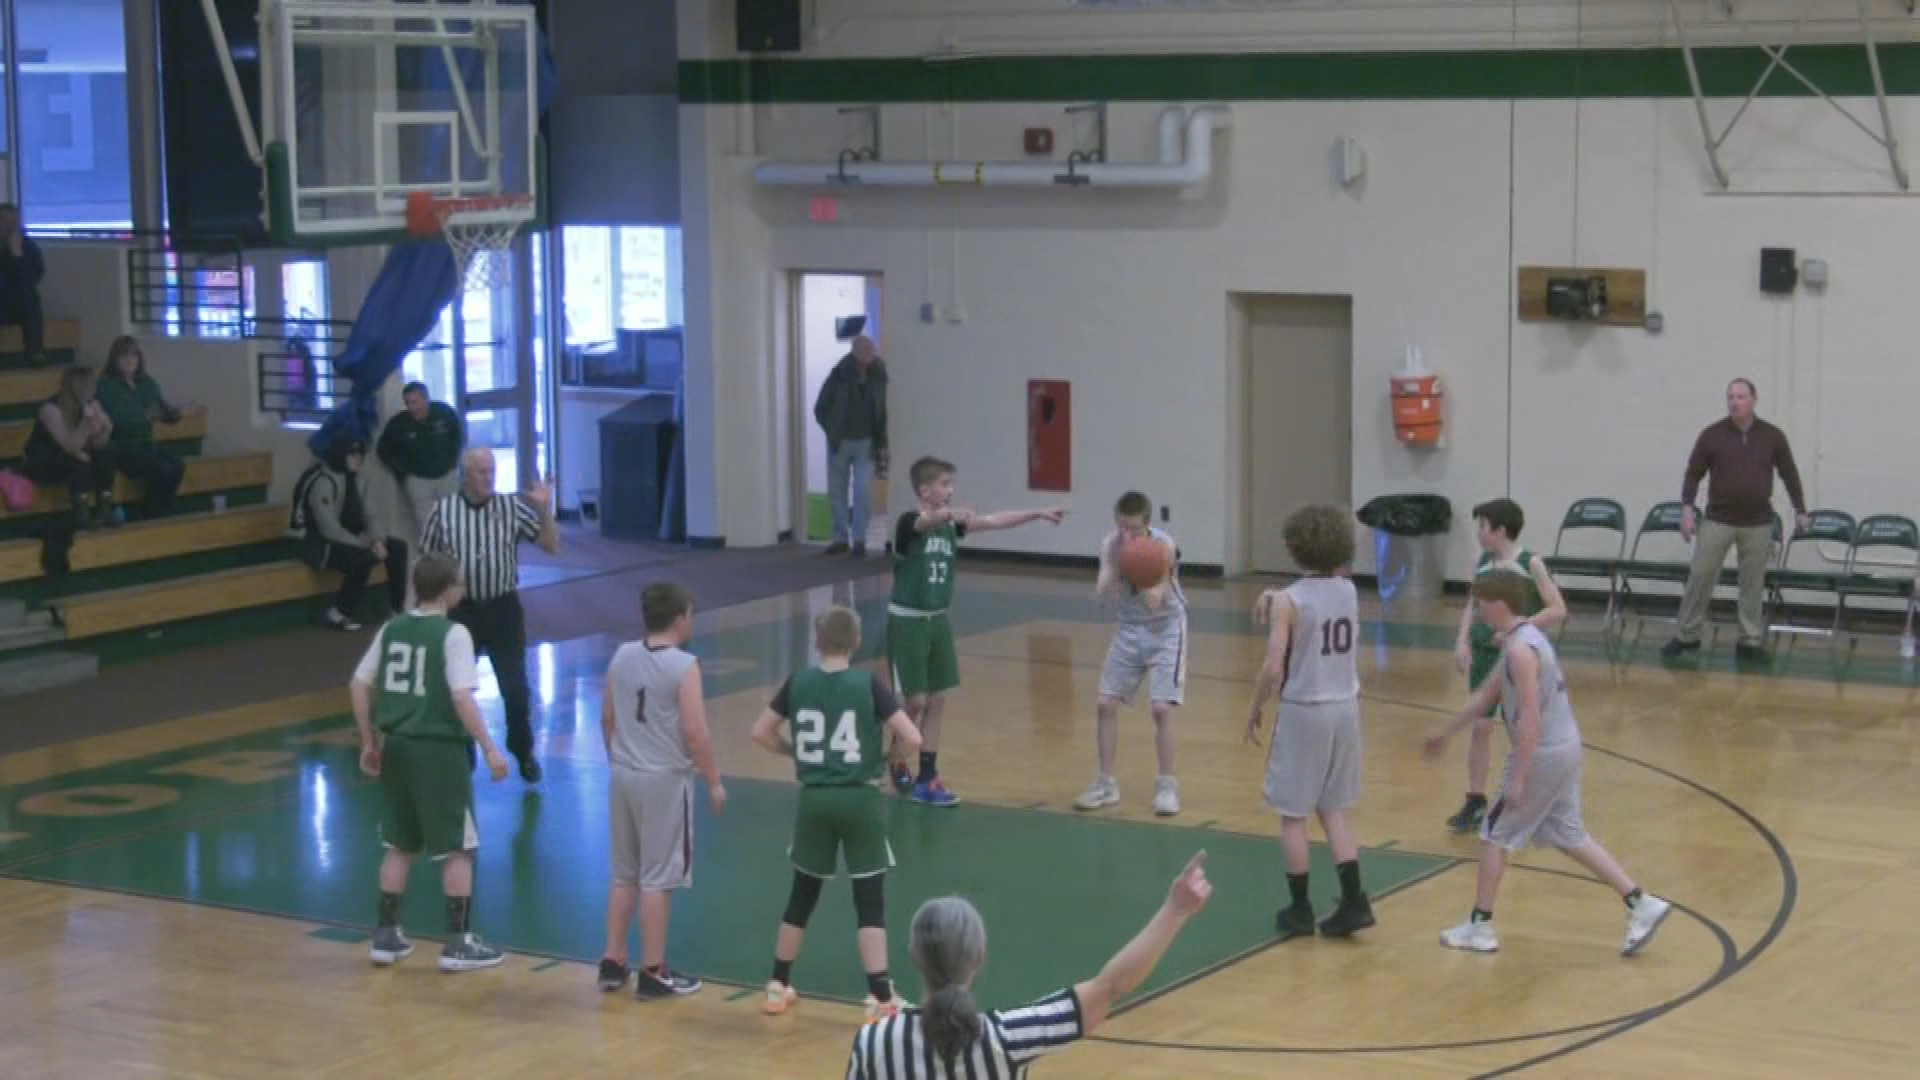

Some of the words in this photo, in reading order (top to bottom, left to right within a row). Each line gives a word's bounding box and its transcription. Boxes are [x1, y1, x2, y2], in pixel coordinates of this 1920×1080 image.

[1320, 617, 1352, 656] 10
[384, 641, 427, 697] 21
[636, 687, 647, 724] 1
[796, 708, 862, 764] 24
